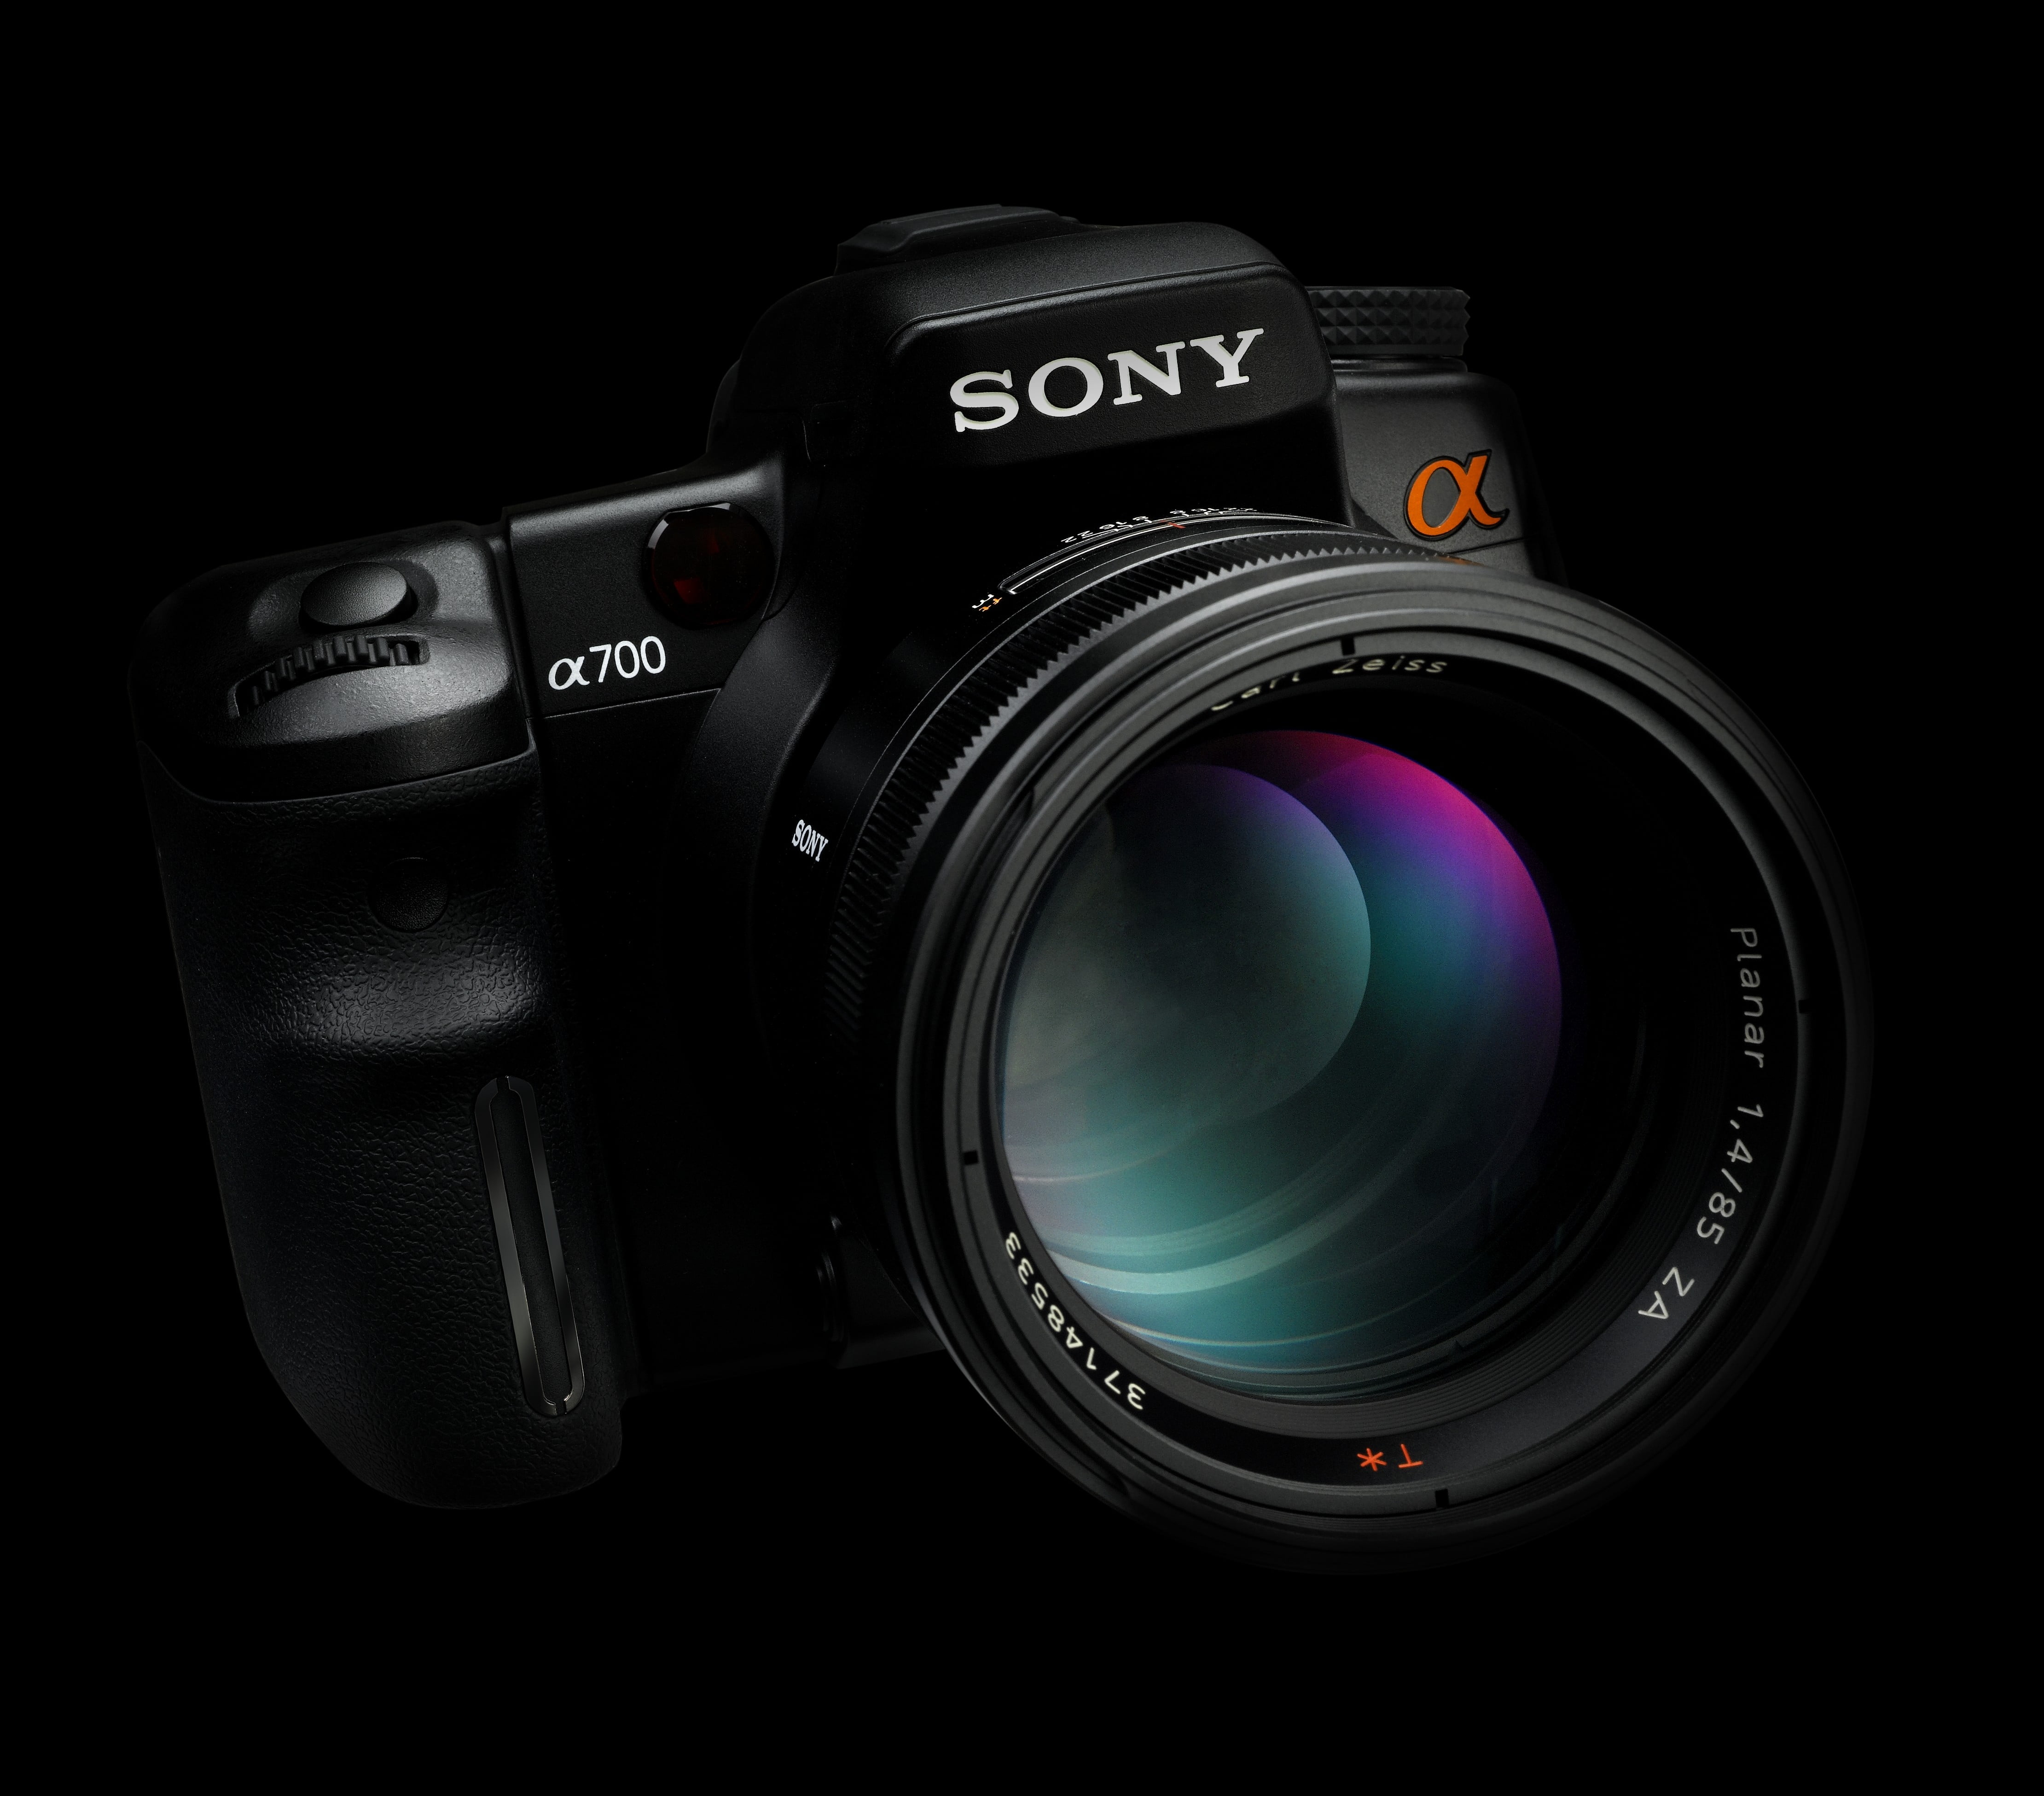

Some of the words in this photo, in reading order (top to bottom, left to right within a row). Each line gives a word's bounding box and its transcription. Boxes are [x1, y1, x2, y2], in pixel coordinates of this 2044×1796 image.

[949, 328, 1265, 432] SONY
[1406, 453, 1504, 538] α
[548, 635, 666, 690] α700
[1211, 671, 1300, 711] arl
[1331, 655, 1448, 674] Zeiss
[791, 819, 829, 862] SONY
[1730, 927, 1765, 1069] Planar
[1696, 1104, 1764, 1244] 1,4/85
[1005, 1232, 1146, 1410] 37148533
[1638, 1266, 1696, 1320] ZA
